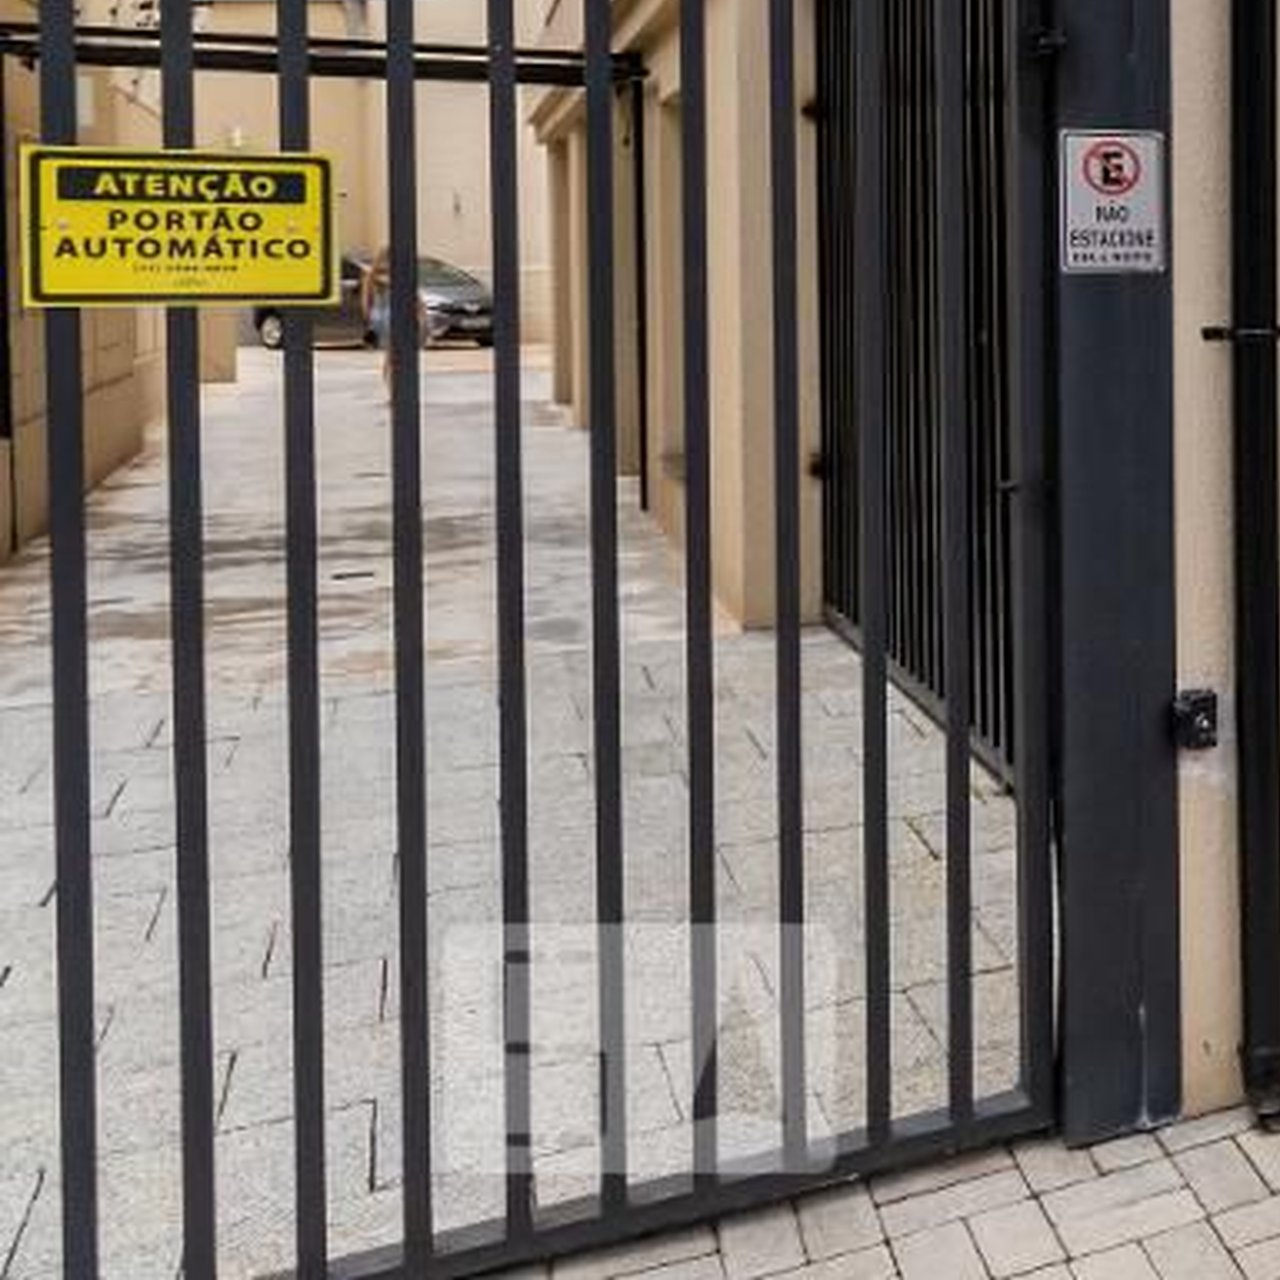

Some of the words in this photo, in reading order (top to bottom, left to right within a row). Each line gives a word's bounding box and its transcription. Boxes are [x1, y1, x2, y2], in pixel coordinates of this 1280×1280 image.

[94, 173, 277, 202] ATENÇÃO
[107, 207, 264, 232] PORTÃO
[1095, 199, 1130, 222] NÃO
[55, 234, 312, 259] AUTOMÁTICO
[1069, 228, 1154, 248] ESTACIONE
